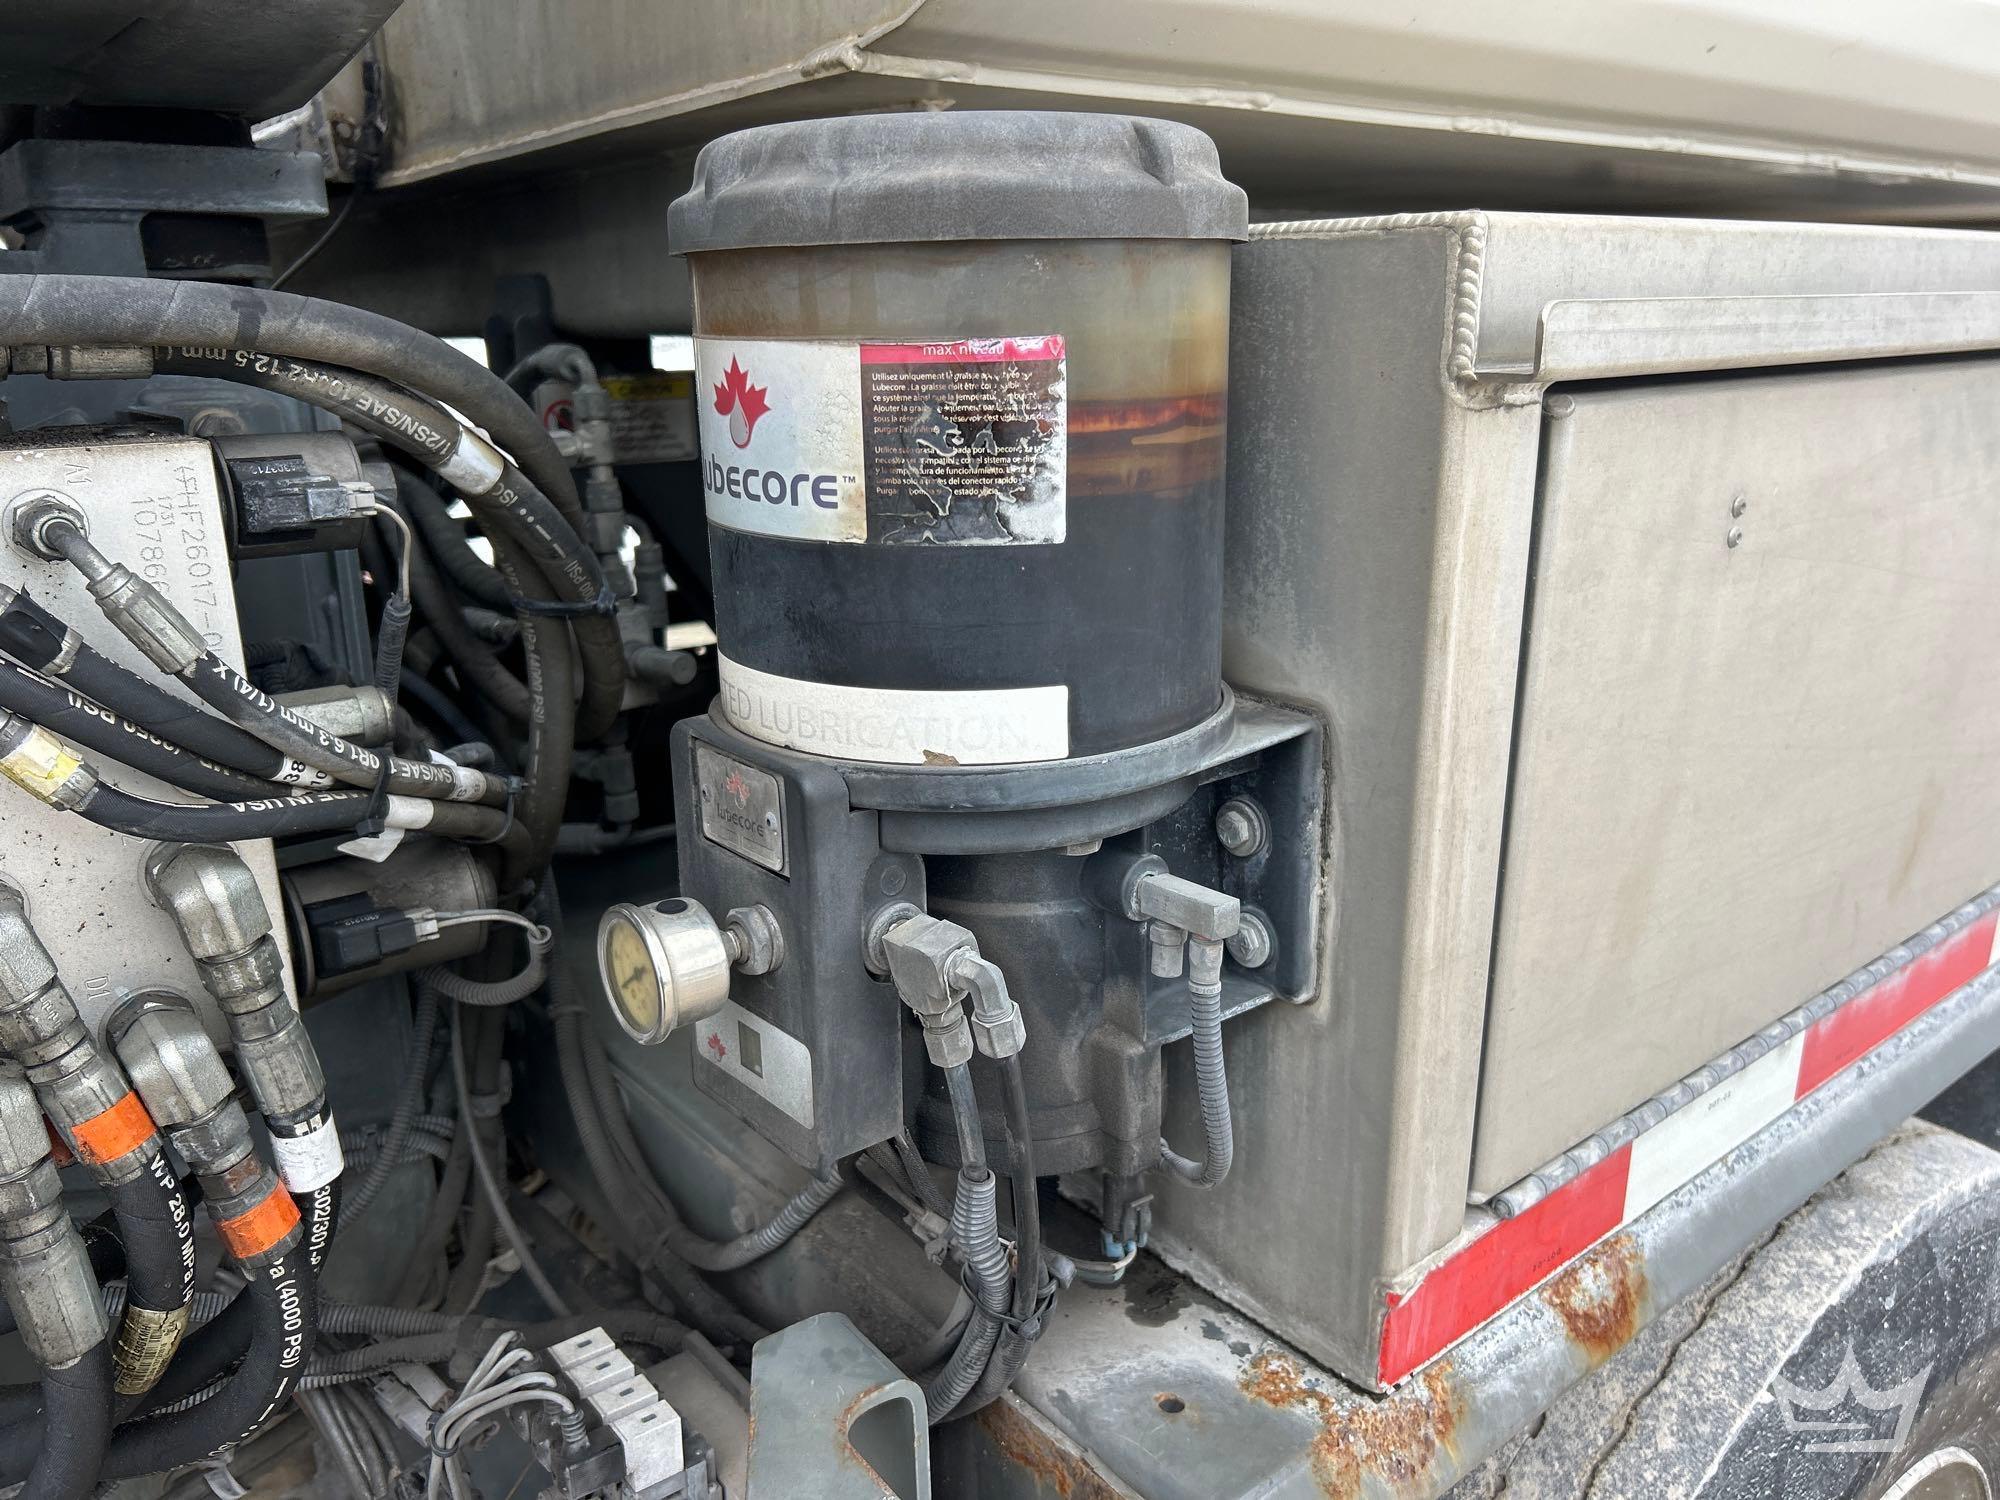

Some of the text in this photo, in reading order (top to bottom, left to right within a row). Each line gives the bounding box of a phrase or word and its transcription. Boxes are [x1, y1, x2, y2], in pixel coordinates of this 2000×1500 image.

[872, 372, 898, 381] Utilisez
[899, 372, 945, 383] uniquement
[872, 383, 906, 392] Lubecore
[882, 394, 912, 404] système
[873, 404, 900, 414] Ajouter
[935, 467, 945, 475] de
[948, 476, 960, 485] del
[961, 477, 993, 486] conector
[954, 487, 979, 496] estado
[233, 676, 276, 713] (1/4)
[279, 705, 314, 736] mm
[318, 728, 345, 755] 6.3
[168, 1192, 191, 1238] 28,0
[179, 1241, 196, 1283] MPa
[277, 1280, 303, 1331] (4000
[279, 1335, 301, 1369] PSI)
